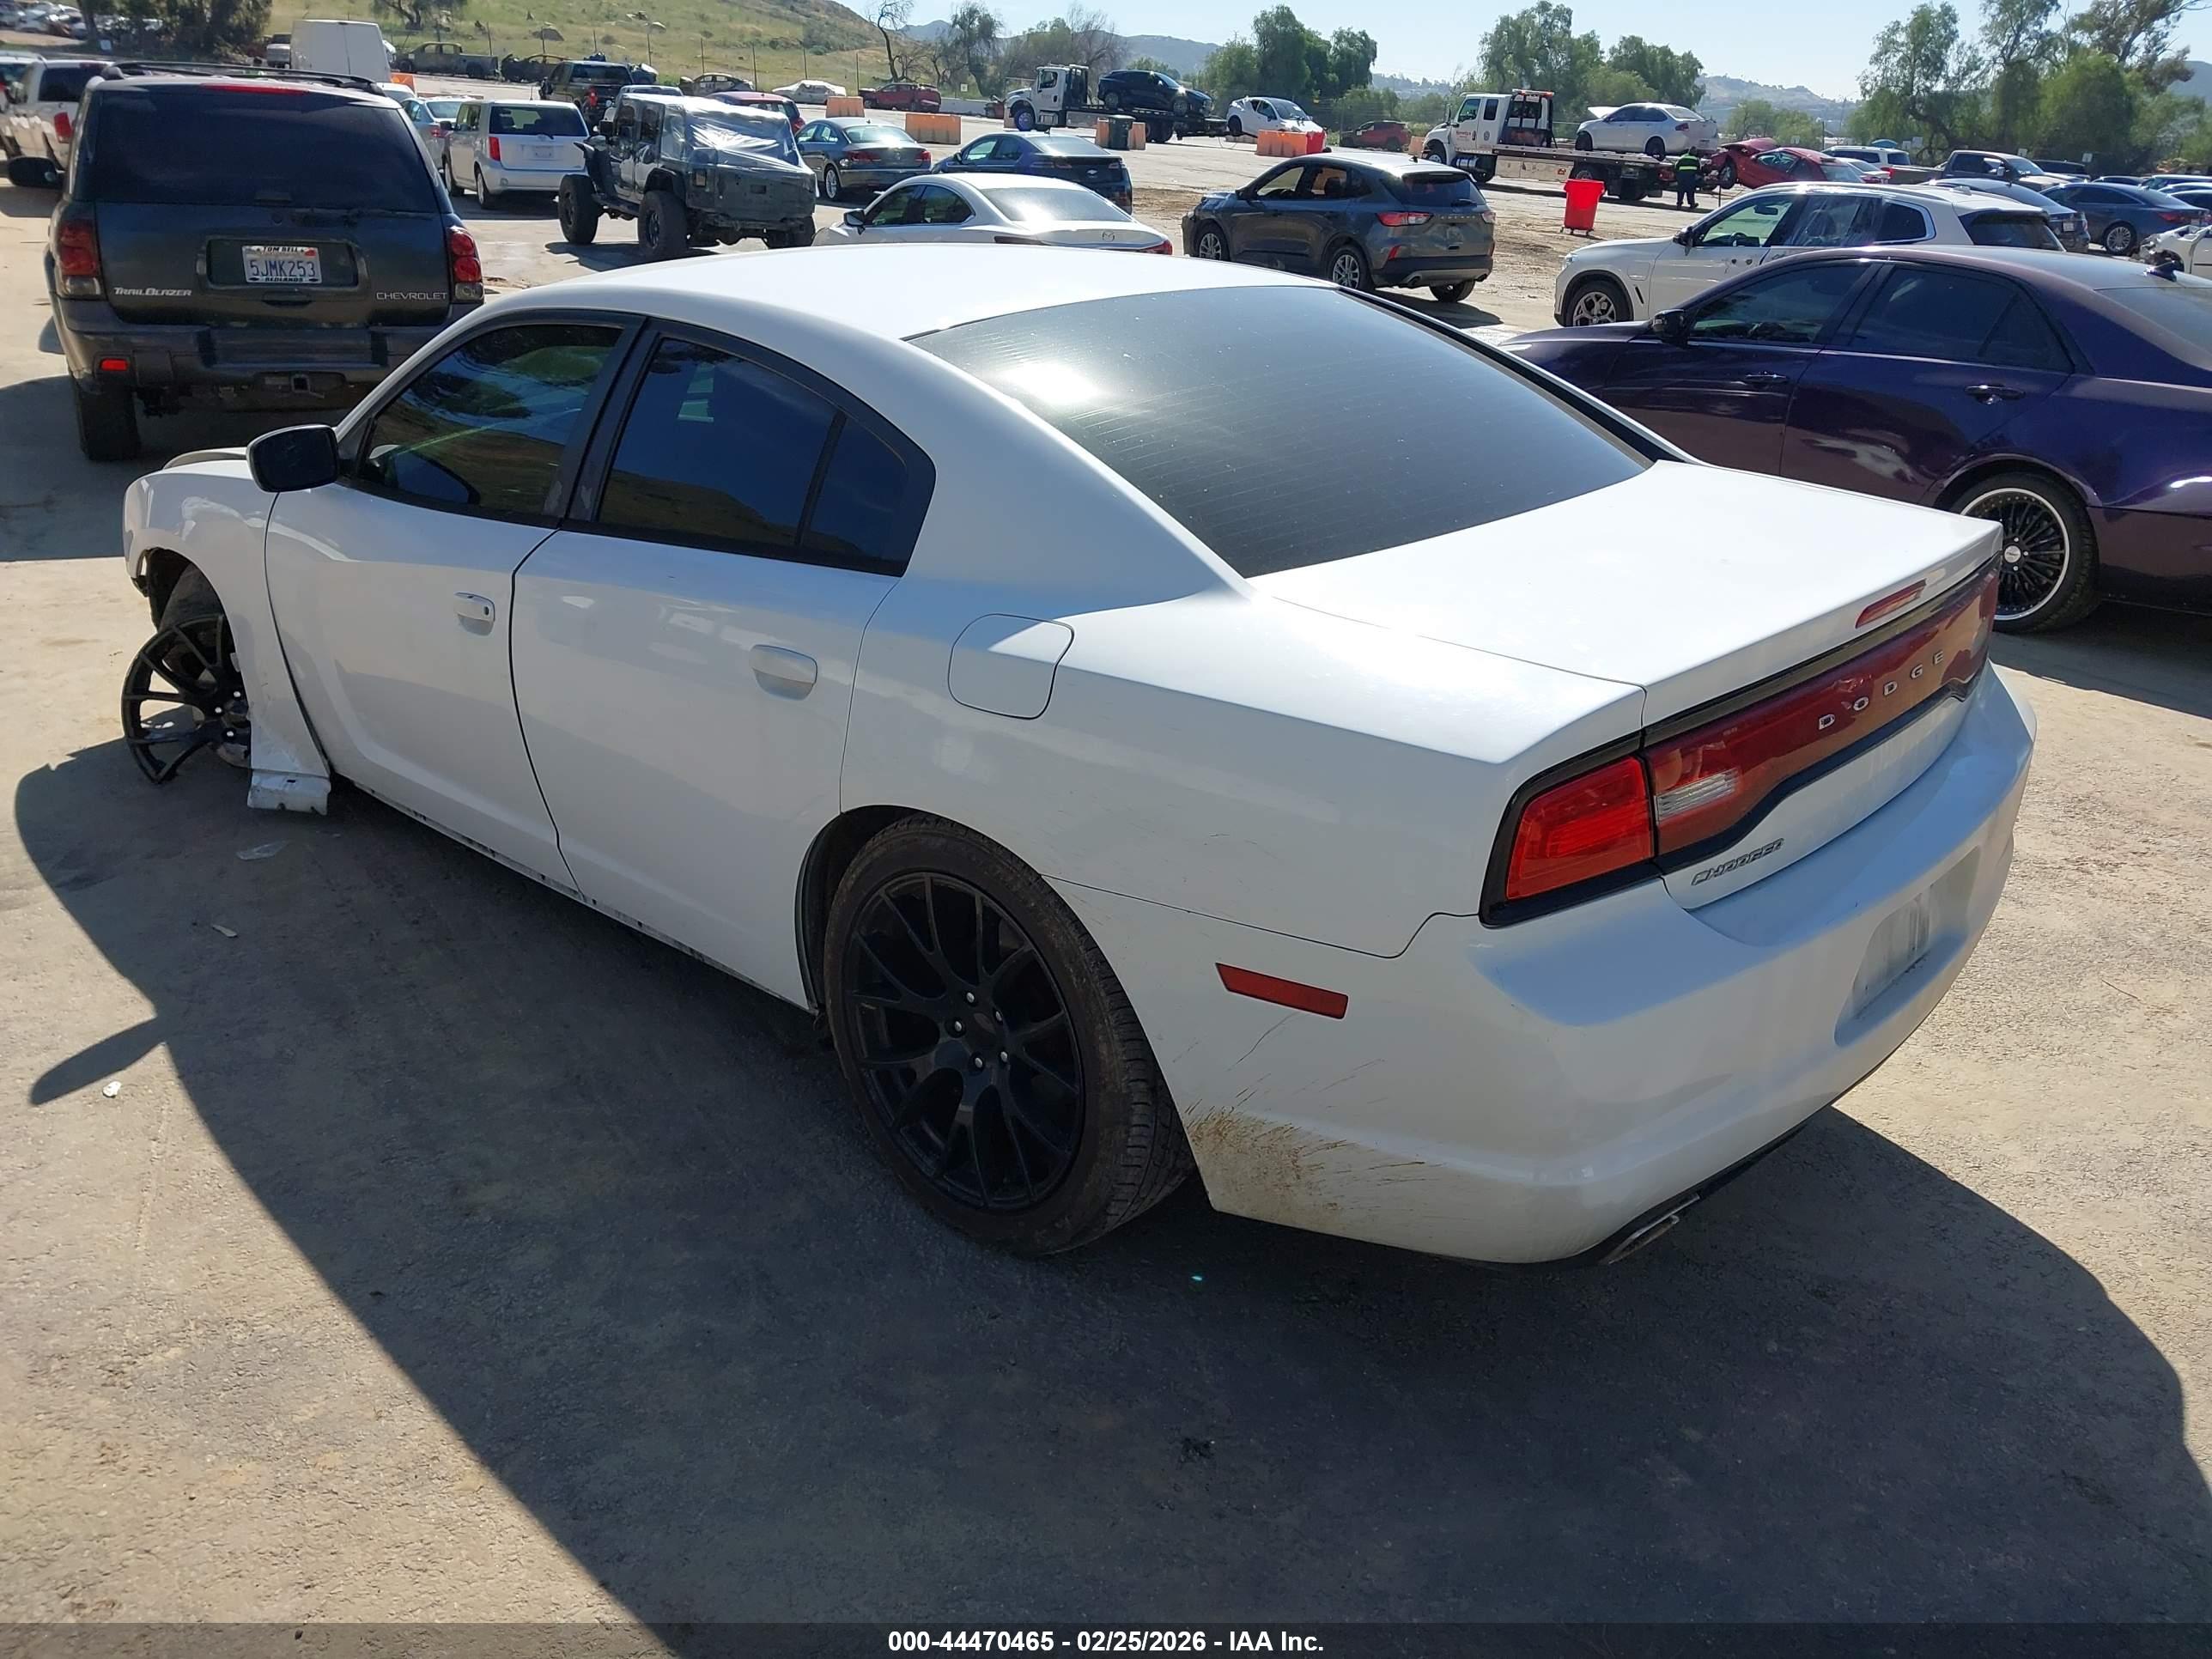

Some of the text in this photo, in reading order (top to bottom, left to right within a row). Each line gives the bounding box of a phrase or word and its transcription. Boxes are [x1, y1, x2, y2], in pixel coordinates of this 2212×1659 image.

[250, 260, 316, 277] 5JMK253
[1818, 651, 1945, 730] DODGE
[1691, 837, 1785, 886] CHARGER
